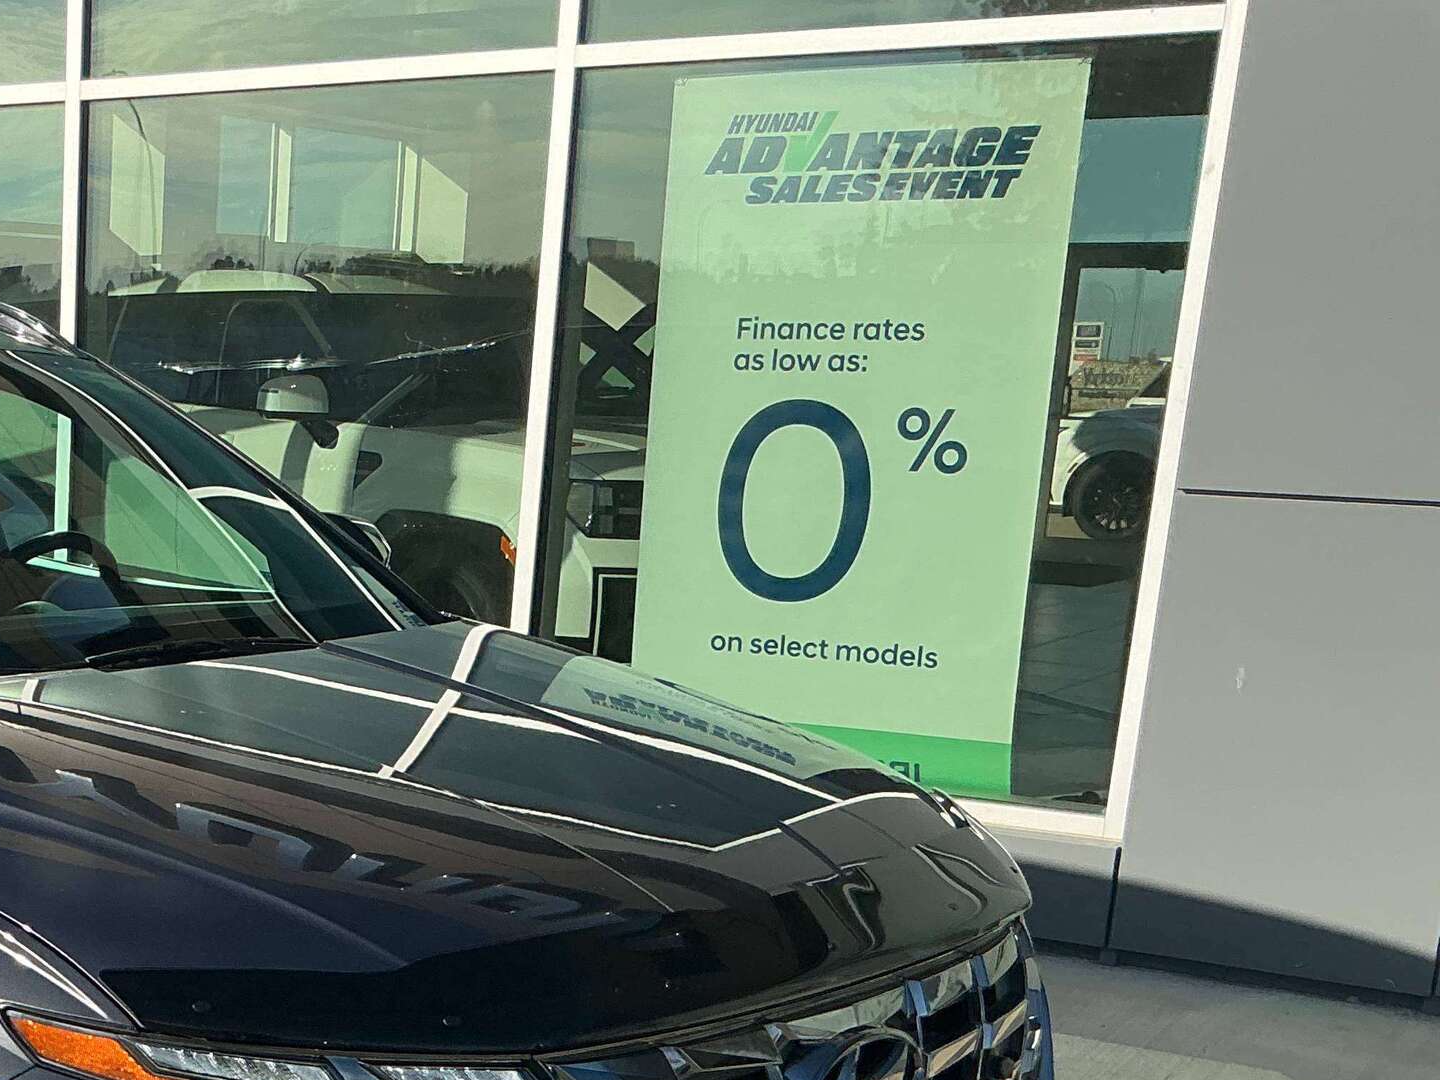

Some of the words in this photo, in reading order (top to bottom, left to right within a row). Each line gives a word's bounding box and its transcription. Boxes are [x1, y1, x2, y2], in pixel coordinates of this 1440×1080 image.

[728, 111, 819, 134] HYUNDAI
[736, 316, 845, 340] Finance
[853, 319, 925, 341] rates
[733, 353, 764, 371] as
[772, 348, 821, 371] low
[827, 354, 868, 372] as:
[710, 634, 743, 652] on
[750, 634, 829, 660] select
[836, 643, 938, 669] models
